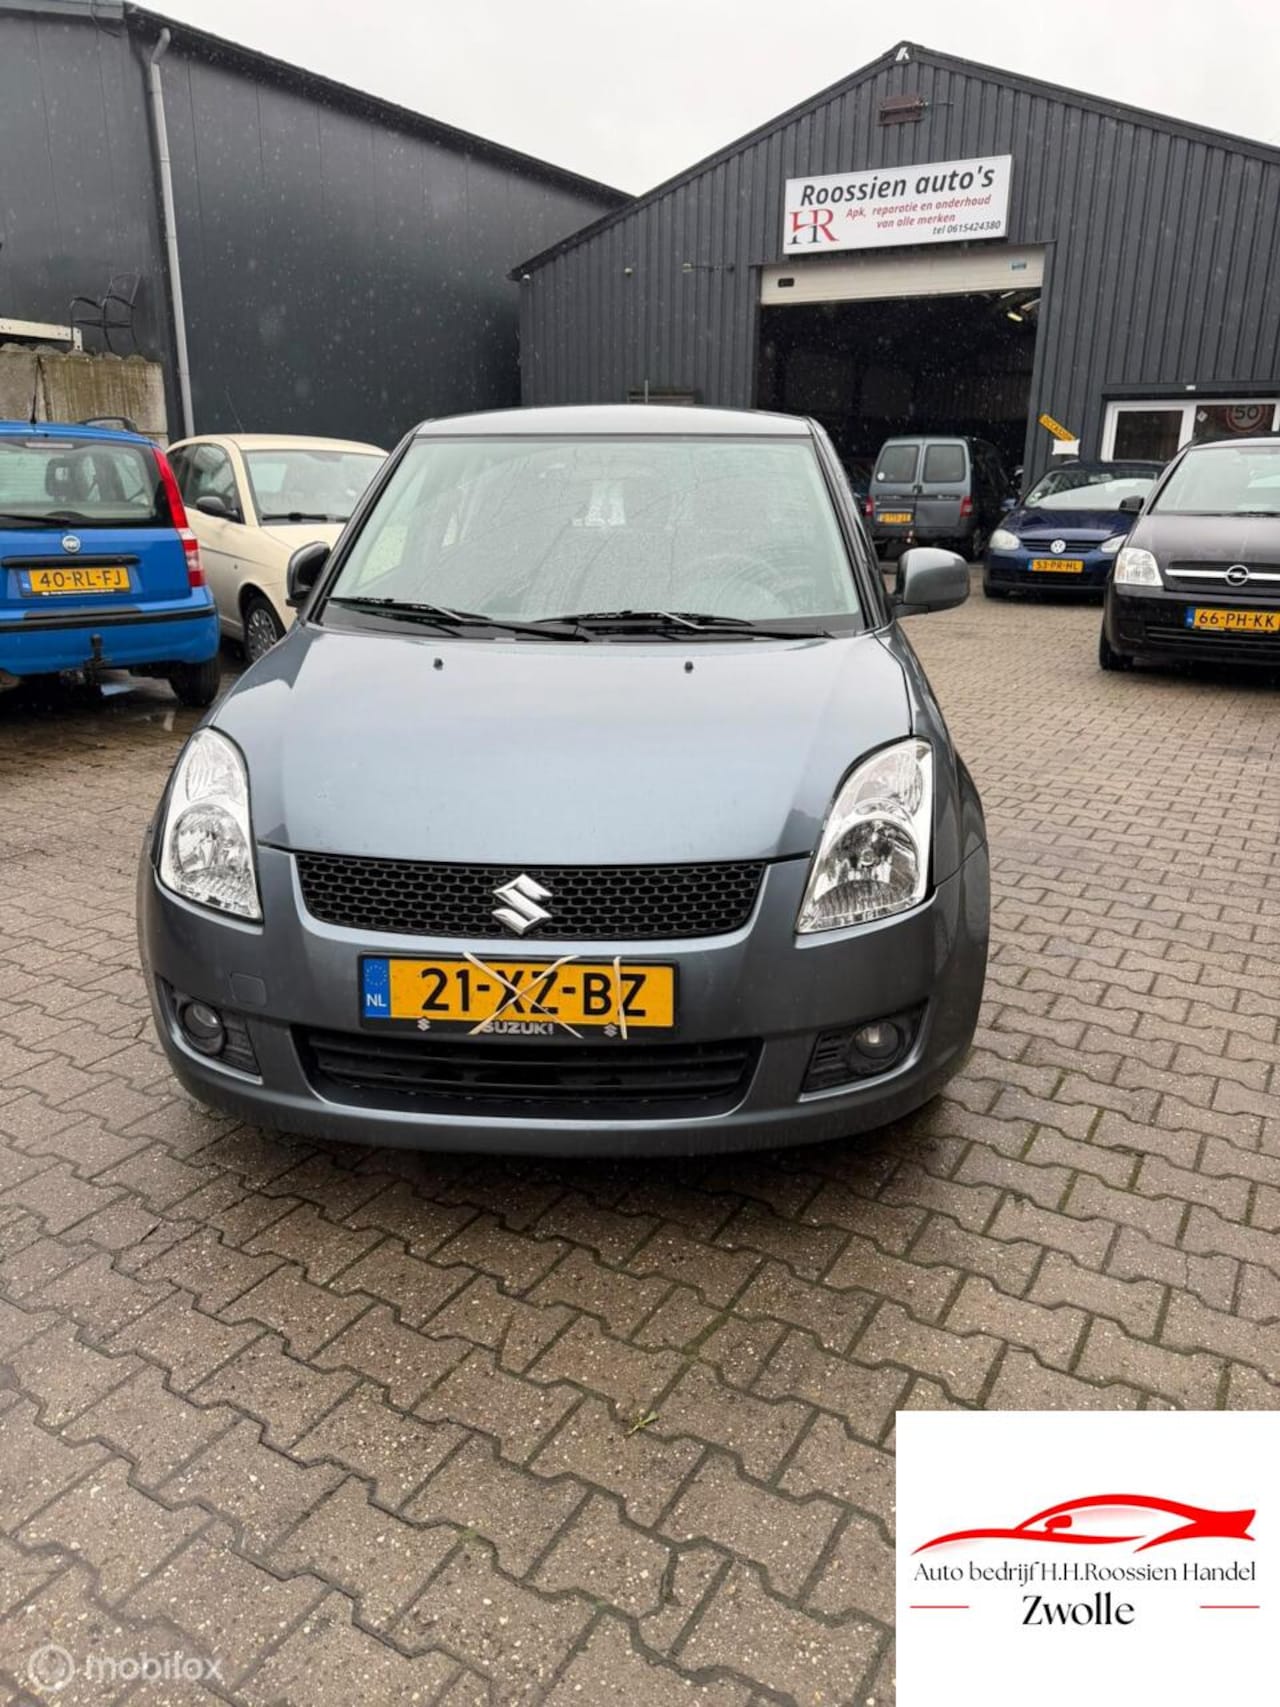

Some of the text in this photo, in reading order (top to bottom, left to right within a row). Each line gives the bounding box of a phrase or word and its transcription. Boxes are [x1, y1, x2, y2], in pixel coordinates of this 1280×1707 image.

[800, 165, 995, 207] Roossien auto's
[846, 194, 992, 219] Apk, reparatie en onderhoud
[876, 212, 956, 229] van alle merken
[932, 220, 1001, 235] tel 0615424380
[1234, 405, 1259, 420] 50
[40, 570, 121, 588] 40-RL-FJ
[1199, 611, 1274, 628] 66-PH-KK
[366, 993, 387, 1008] NL
[420, 967, 647, 1018] 21-XZ-BZ
[482, 1021, 554, 1036] SUZUKI
